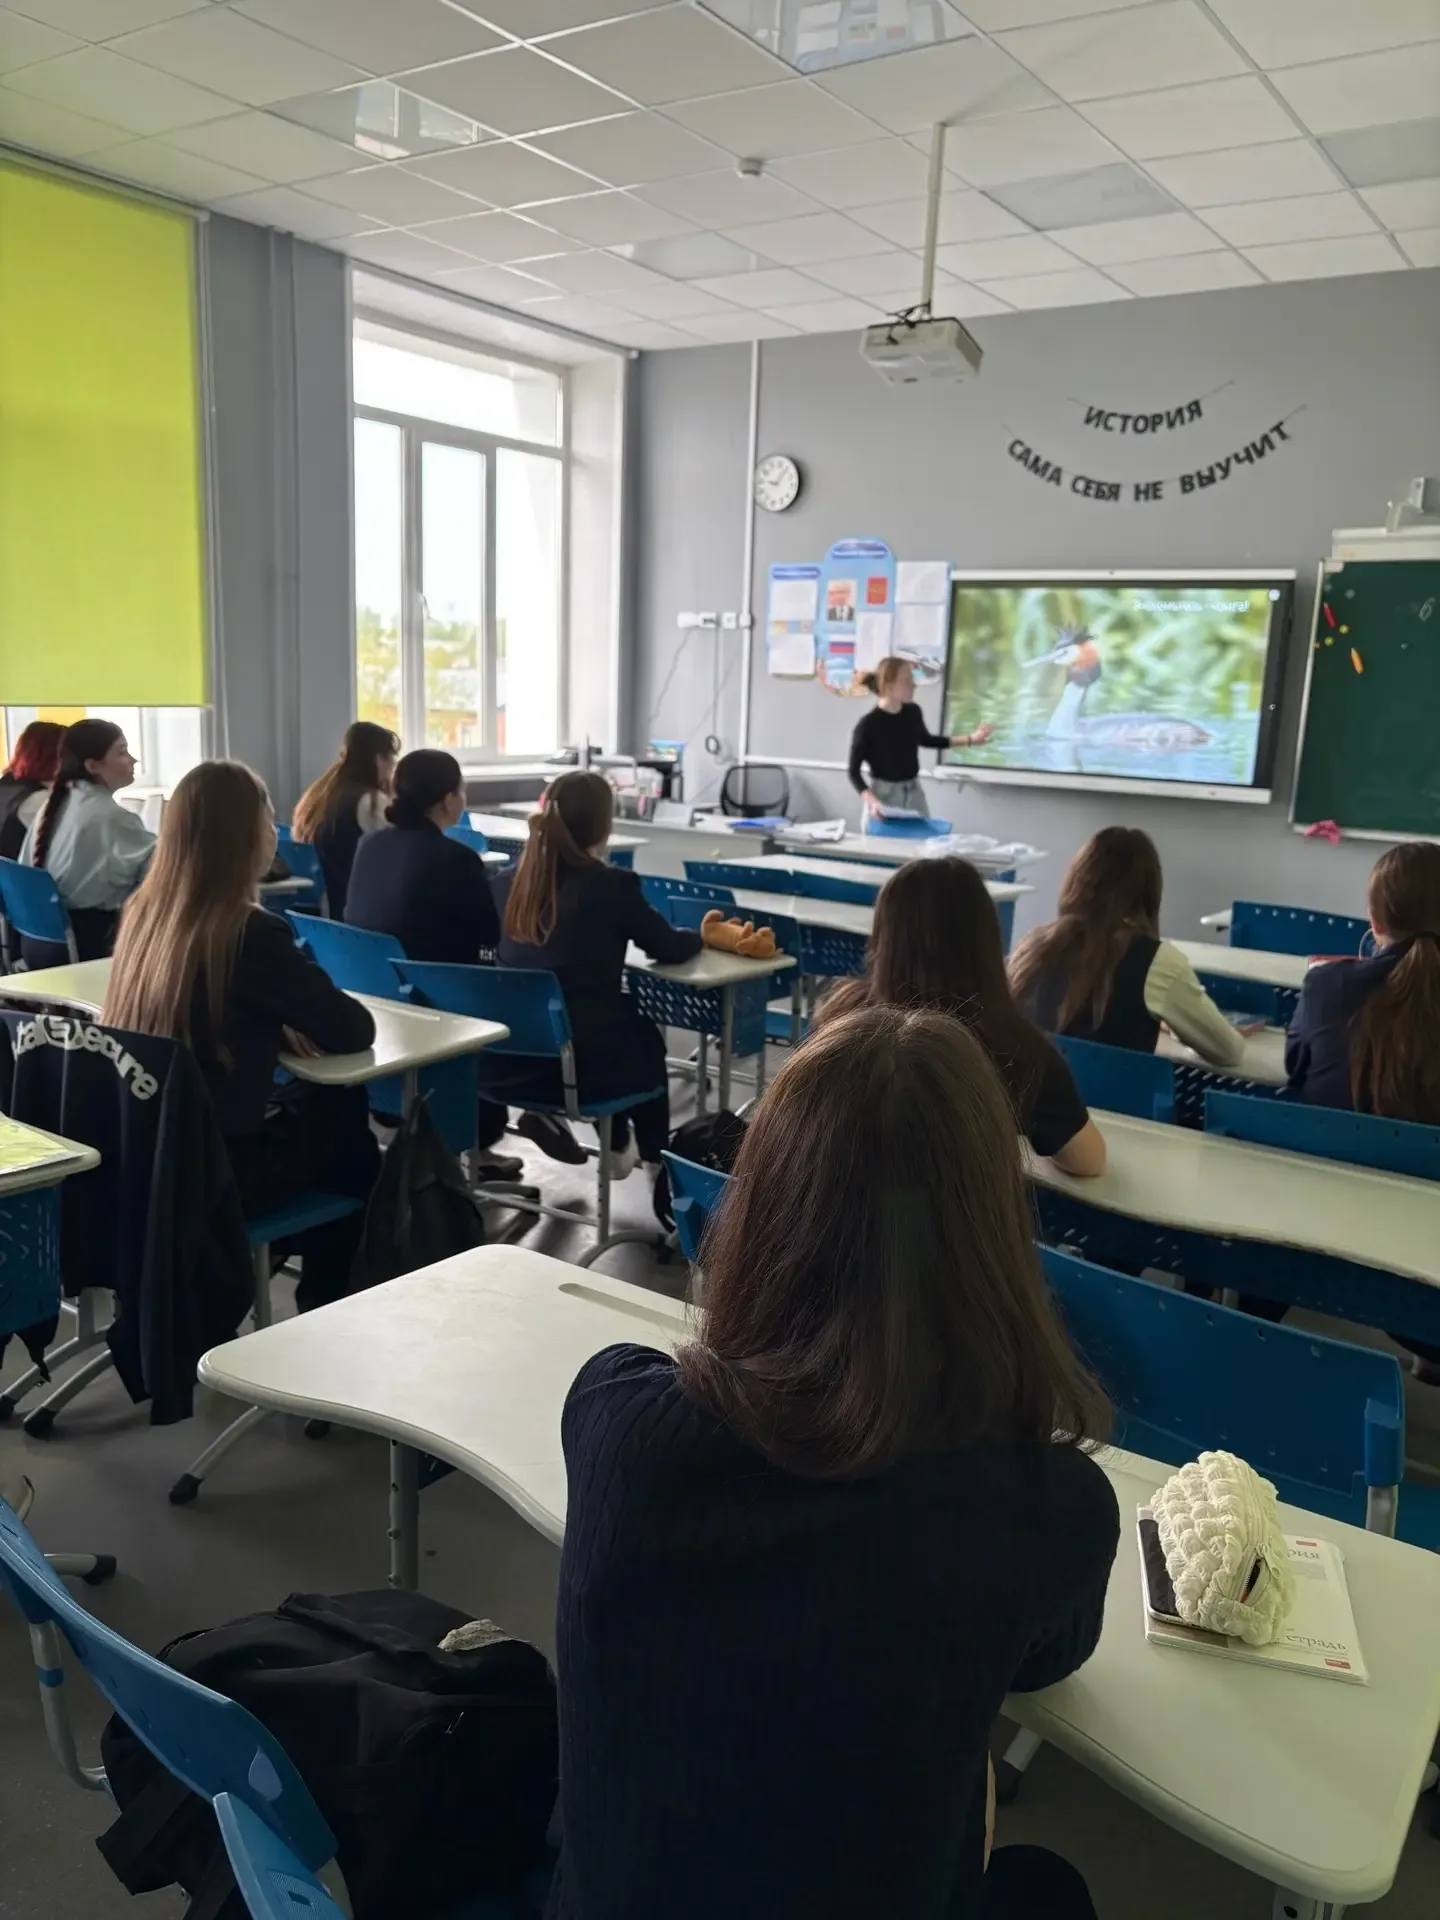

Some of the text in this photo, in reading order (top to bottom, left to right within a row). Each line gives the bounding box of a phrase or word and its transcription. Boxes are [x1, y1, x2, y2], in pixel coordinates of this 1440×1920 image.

[1083, 399, 1204, 435] ИСТОРИЯ
[1007, 420, 1291, 503] САМА СЕБЯ НЕ ВЫУЧИТ
